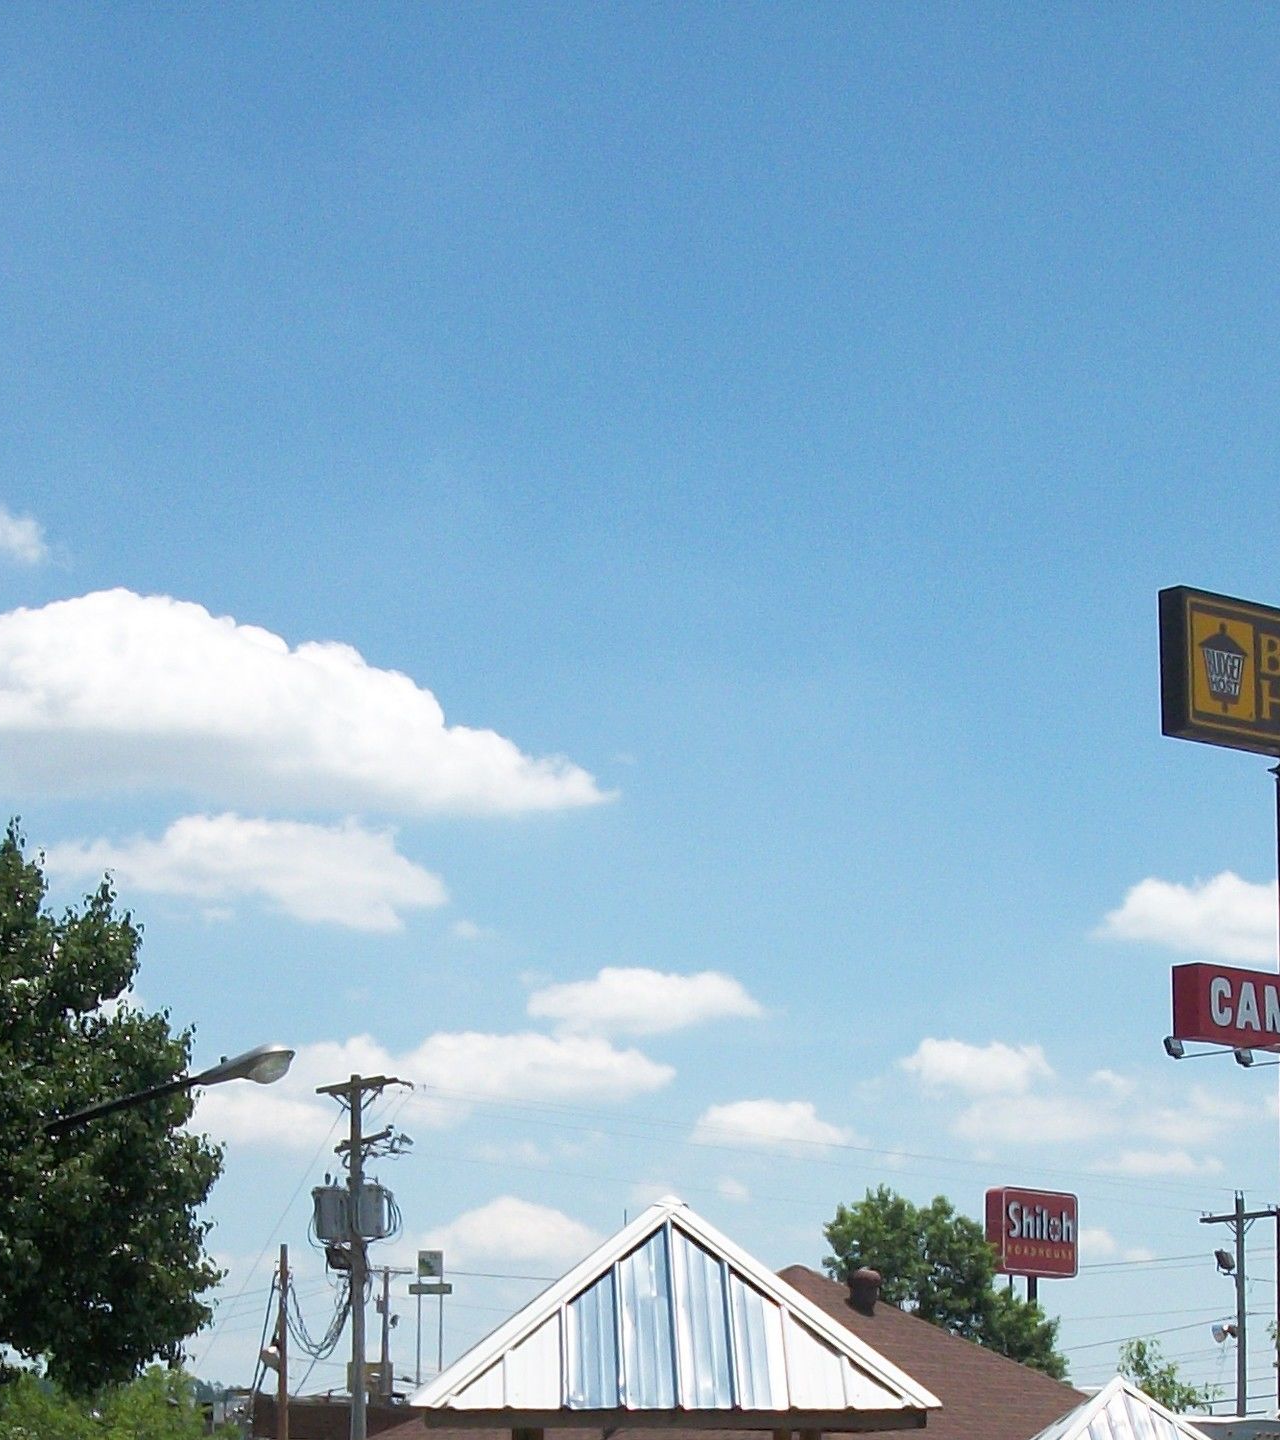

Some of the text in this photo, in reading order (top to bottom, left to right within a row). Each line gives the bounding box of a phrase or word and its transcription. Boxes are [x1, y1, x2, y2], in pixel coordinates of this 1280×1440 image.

[1206, 649, 1241, 680] BUDGET
[1210, 677, 1239, 696] HOST
[1007, 1200, 1075, 1243] Shiloh
